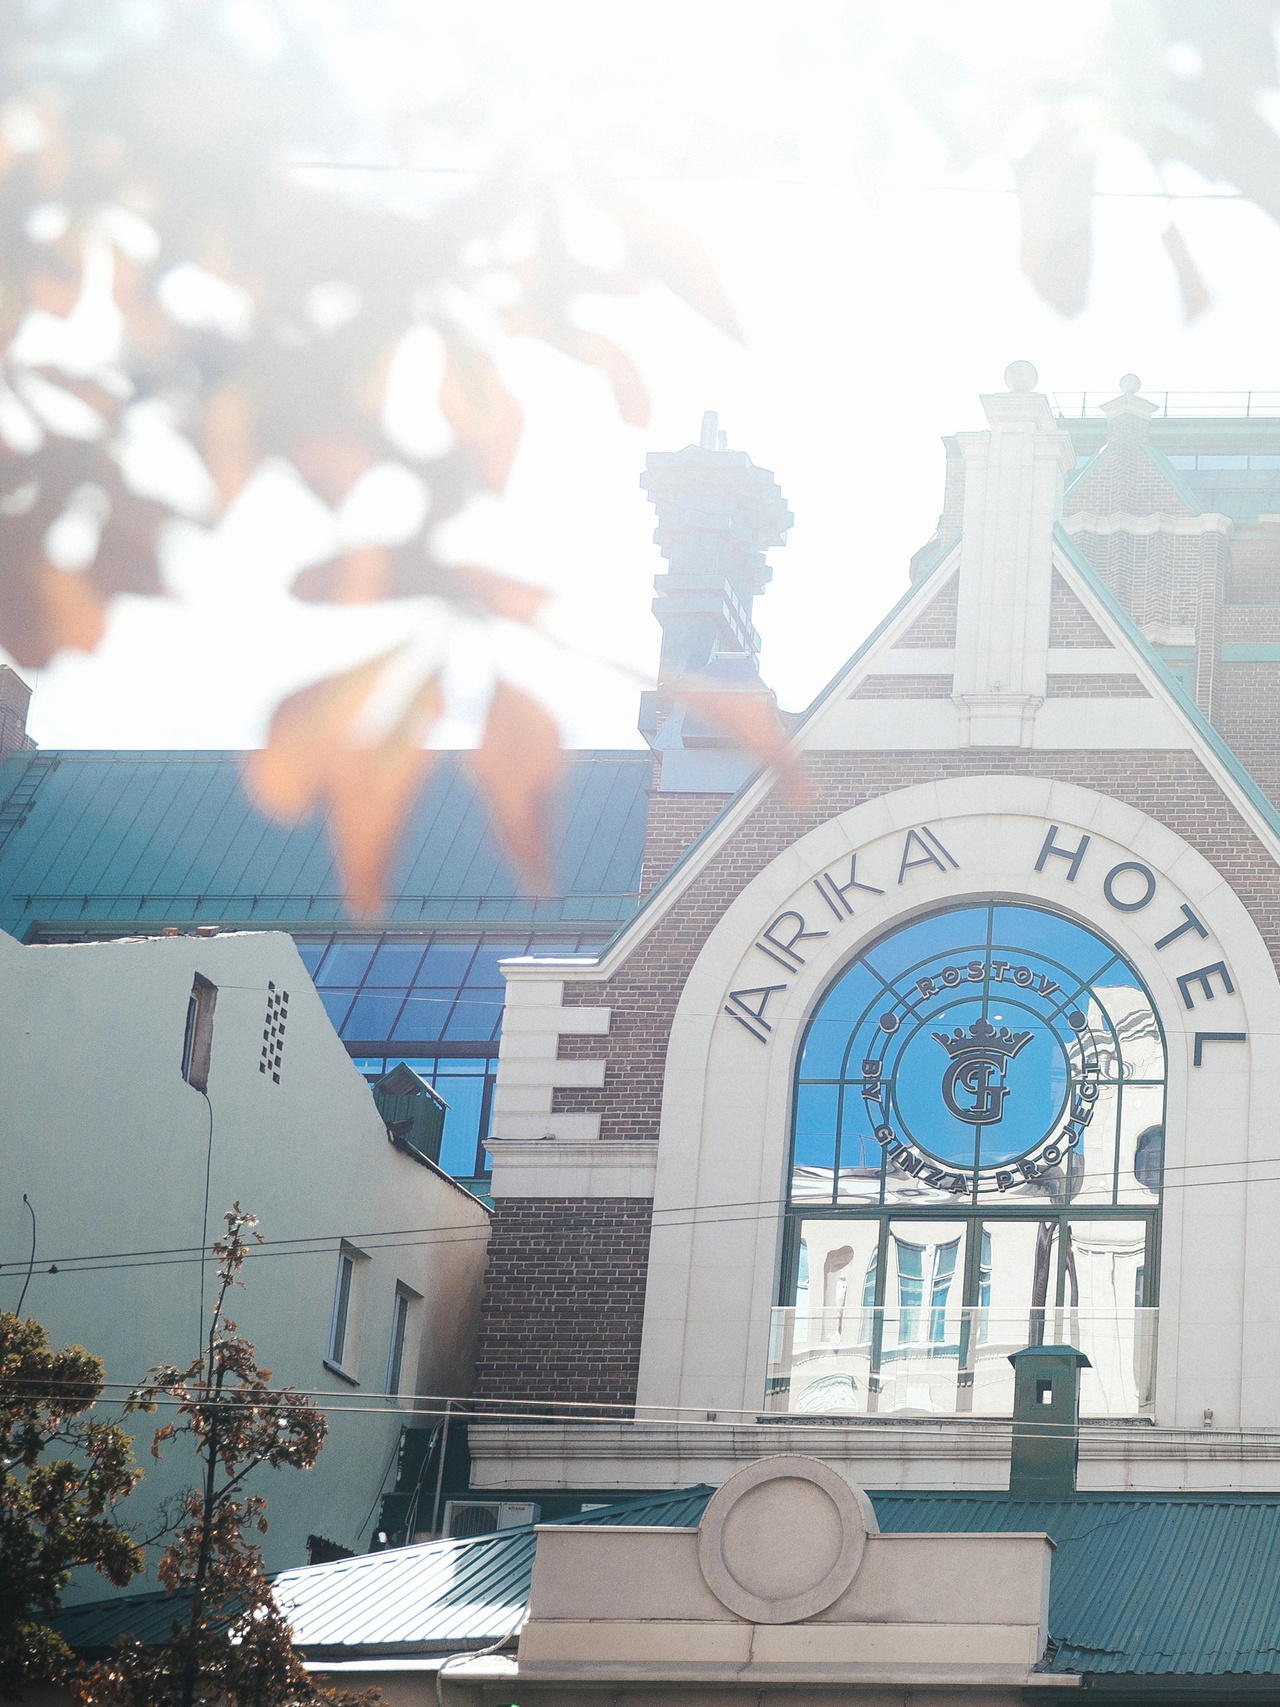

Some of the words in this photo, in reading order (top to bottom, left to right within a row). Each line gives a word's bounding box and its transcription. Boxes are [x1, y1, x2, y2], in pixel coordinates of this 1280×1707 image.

[915, 961, 1059, 1000] ROSTOV
[1034, 825, 1246, 1068] HOTEL
[861, 1059, 884, 1103] BY
[875, 1124, 970, 1195] GINZA
[995, 1058, 1101, 1193] PROJECT
